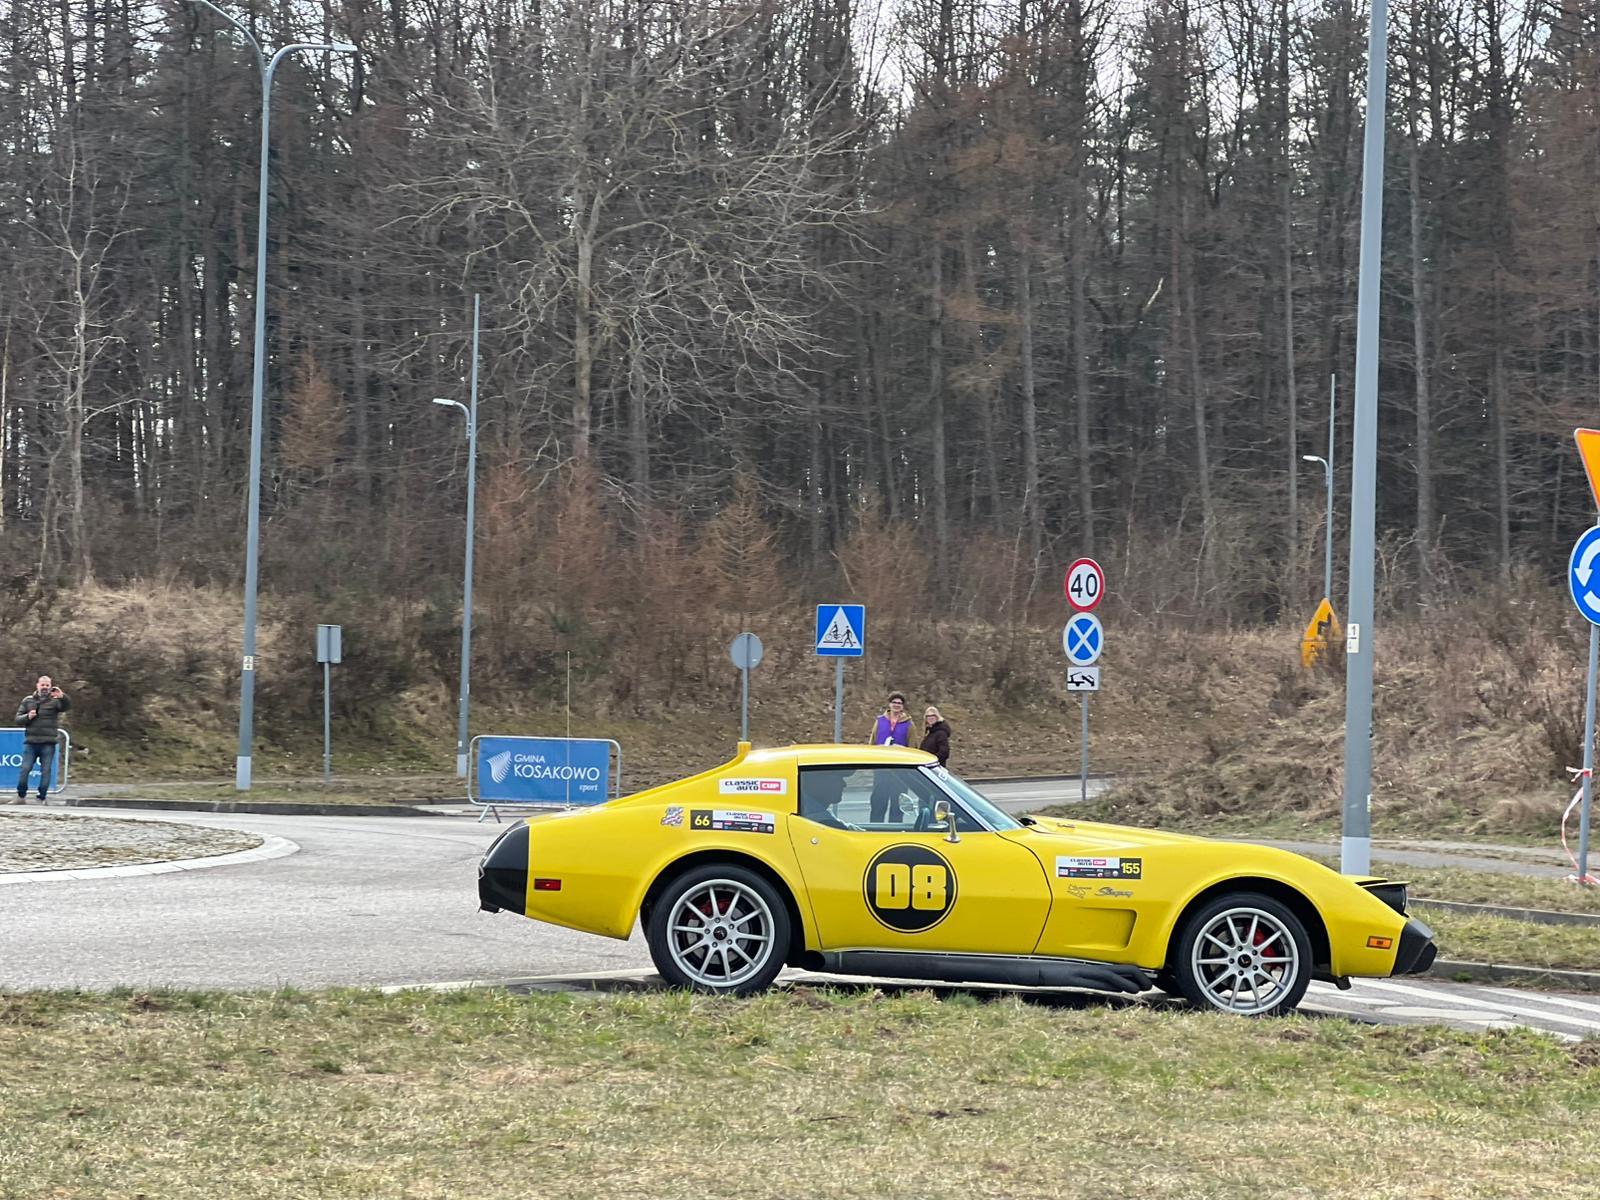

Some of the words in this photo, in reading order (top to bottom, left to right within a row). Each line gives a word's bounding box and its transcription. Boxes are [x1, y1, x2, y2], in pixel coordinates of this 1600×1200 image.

[1070, 573, 1098, 598] 40
[514, 754, 545, 764] GMINA
[514, 764, 600, 781] KOSAKOWO
[694, 814, 710, 826] 66
[1120, 862, 1140, 874] 155
[876, 863, 946, 911] 08
